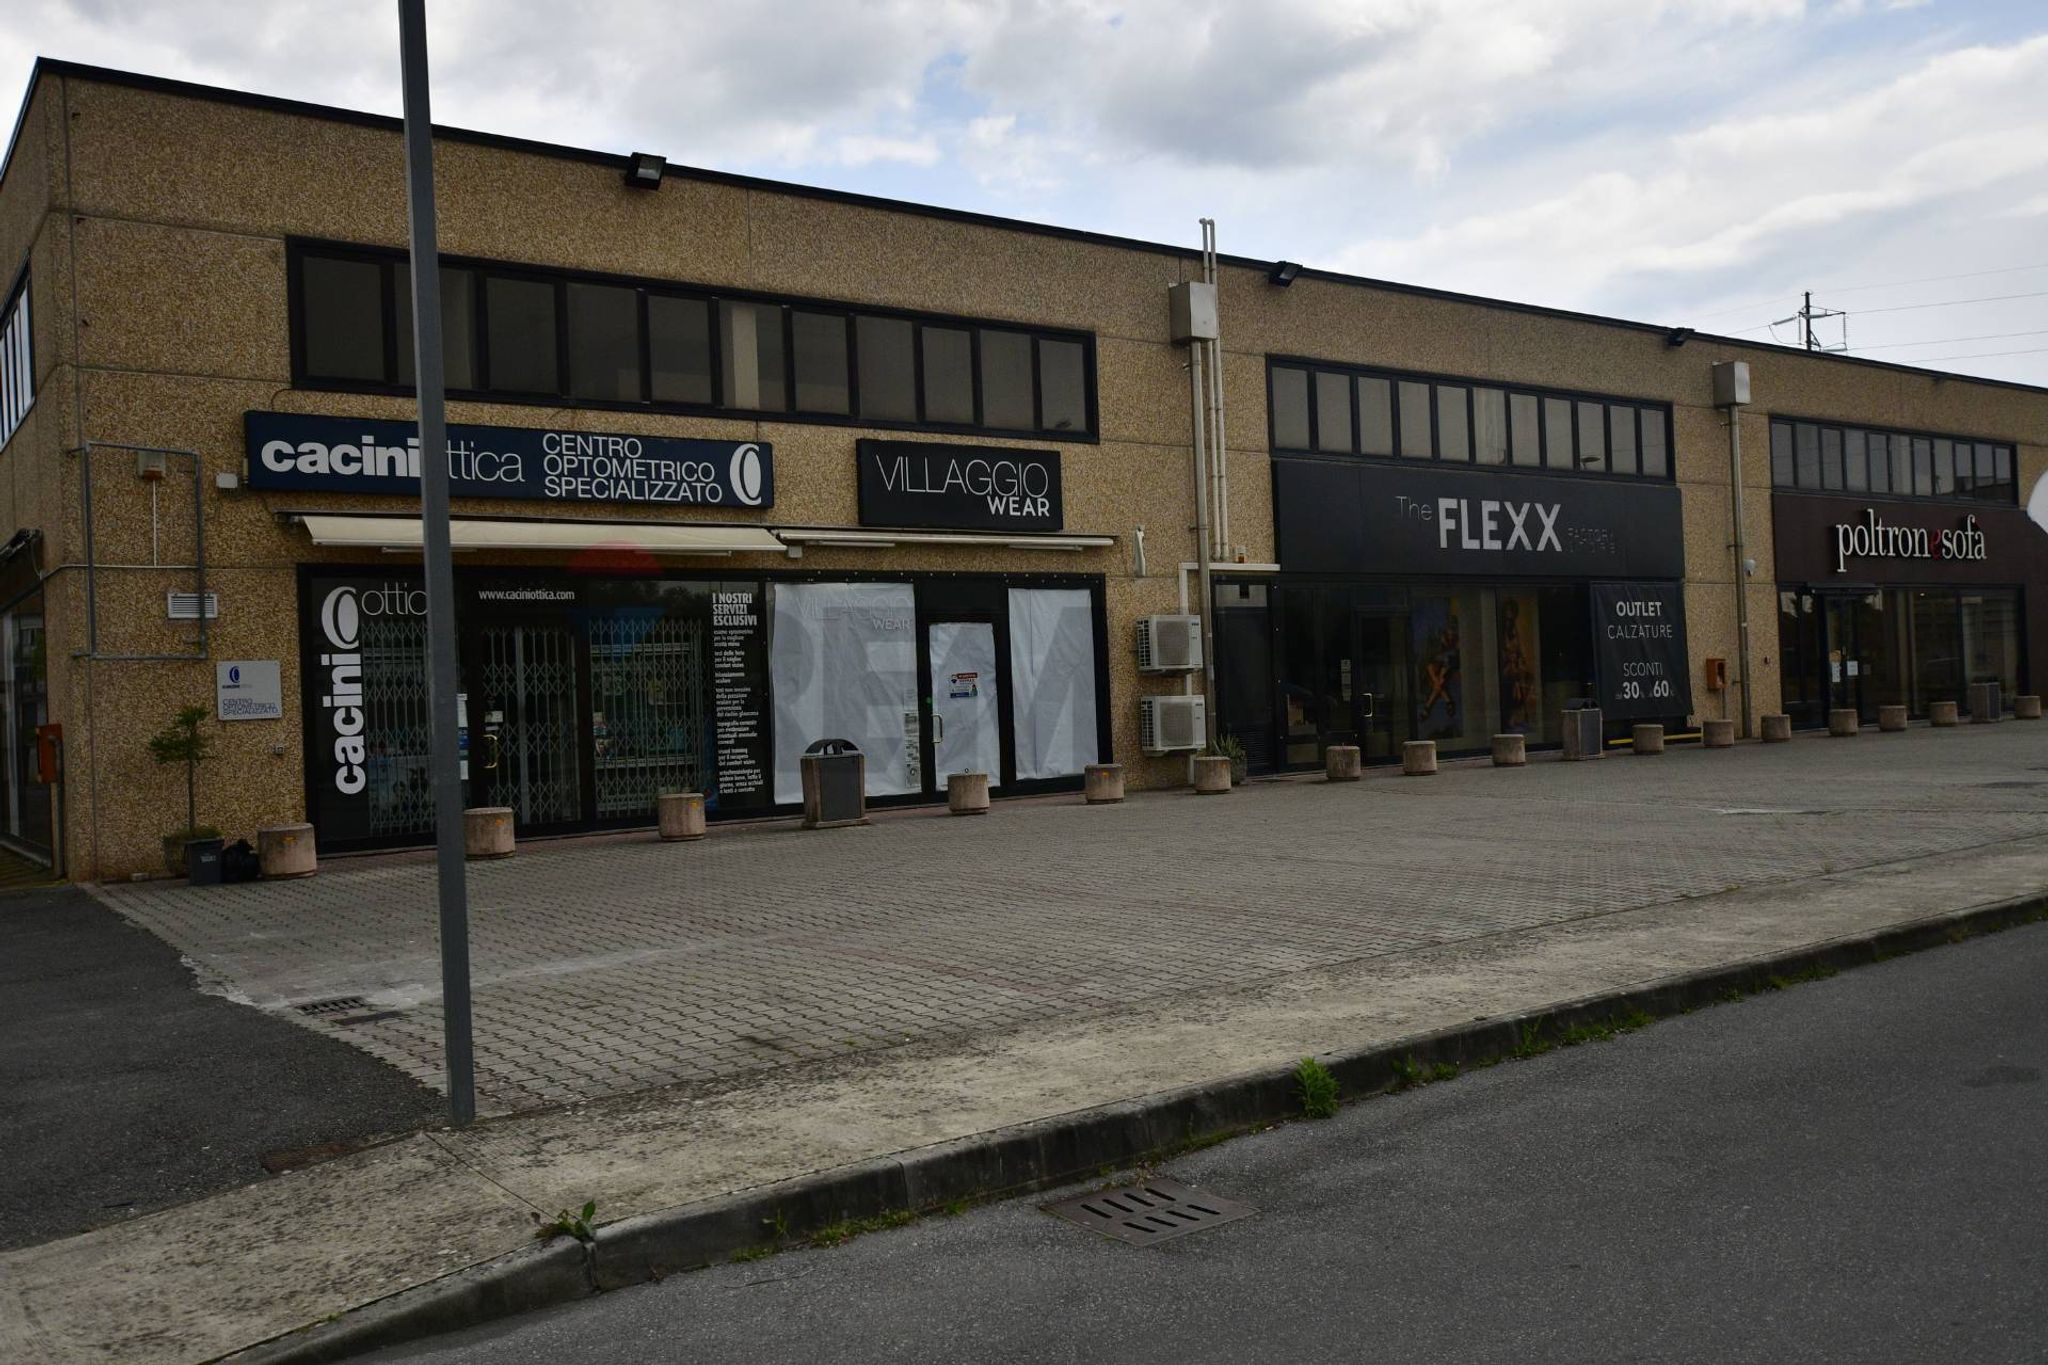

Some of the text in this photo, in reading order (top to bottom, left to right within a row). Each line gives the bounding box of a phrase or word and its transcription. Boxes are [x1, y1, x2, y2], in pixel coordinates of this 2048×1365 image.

[542, 433, 642, 458] CENTRO
[261, 435, 525, 483] cacini ttica
[543, 455, 715, 483] OPTOMETRICO
[876, 454, 1049, 497] VILLAGGIO
[544, 476, 723, 503] SPECIALIZZATO
[987, 496, 1050, 517] WEAR
[1395, 495, 1433, 521] The
[1438, 497, 1563, 552] FLEXX
[361, 582, 429, 615] ottic
[478, 587, 575, 600] www.caciniottica.com
[718, 592, 752, 604] NOSTRI
[712, 603, 747, 615] SERVIZI
[713, 614, 758, 626] ESCLUSIVI
[1616, 601, 1662, 617] OUTLET
[872, 617, 912, 630] WEAR
[1607, 624, 1673, 639] CALZATURE
[1623, 662, 1663, 677] SCONTI
[321, 653, 367, 795] cacini
